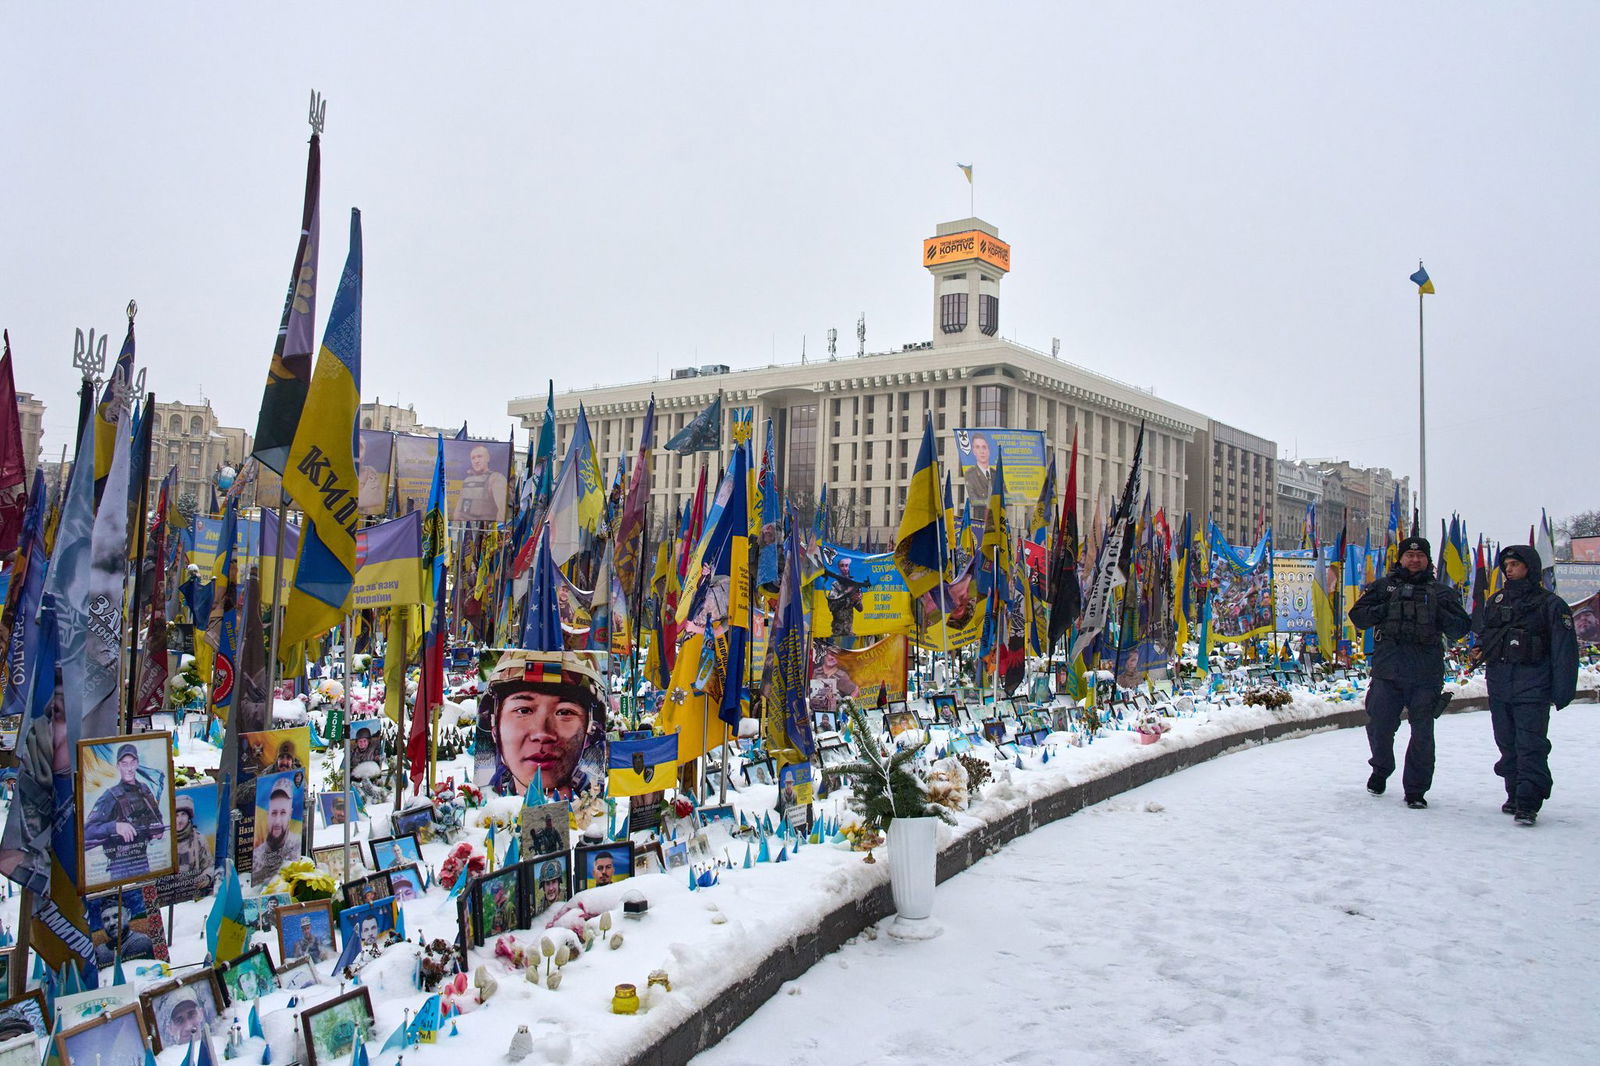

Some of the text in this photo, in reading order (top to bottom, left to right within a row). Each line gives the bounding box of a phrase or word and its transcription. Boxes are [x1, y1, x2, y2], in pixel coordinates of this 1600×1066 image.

[940, 242, 974, 255] КОРПУС
[330, 712, 338, 738] 2025
[239, 826, 254, 835] Наза
